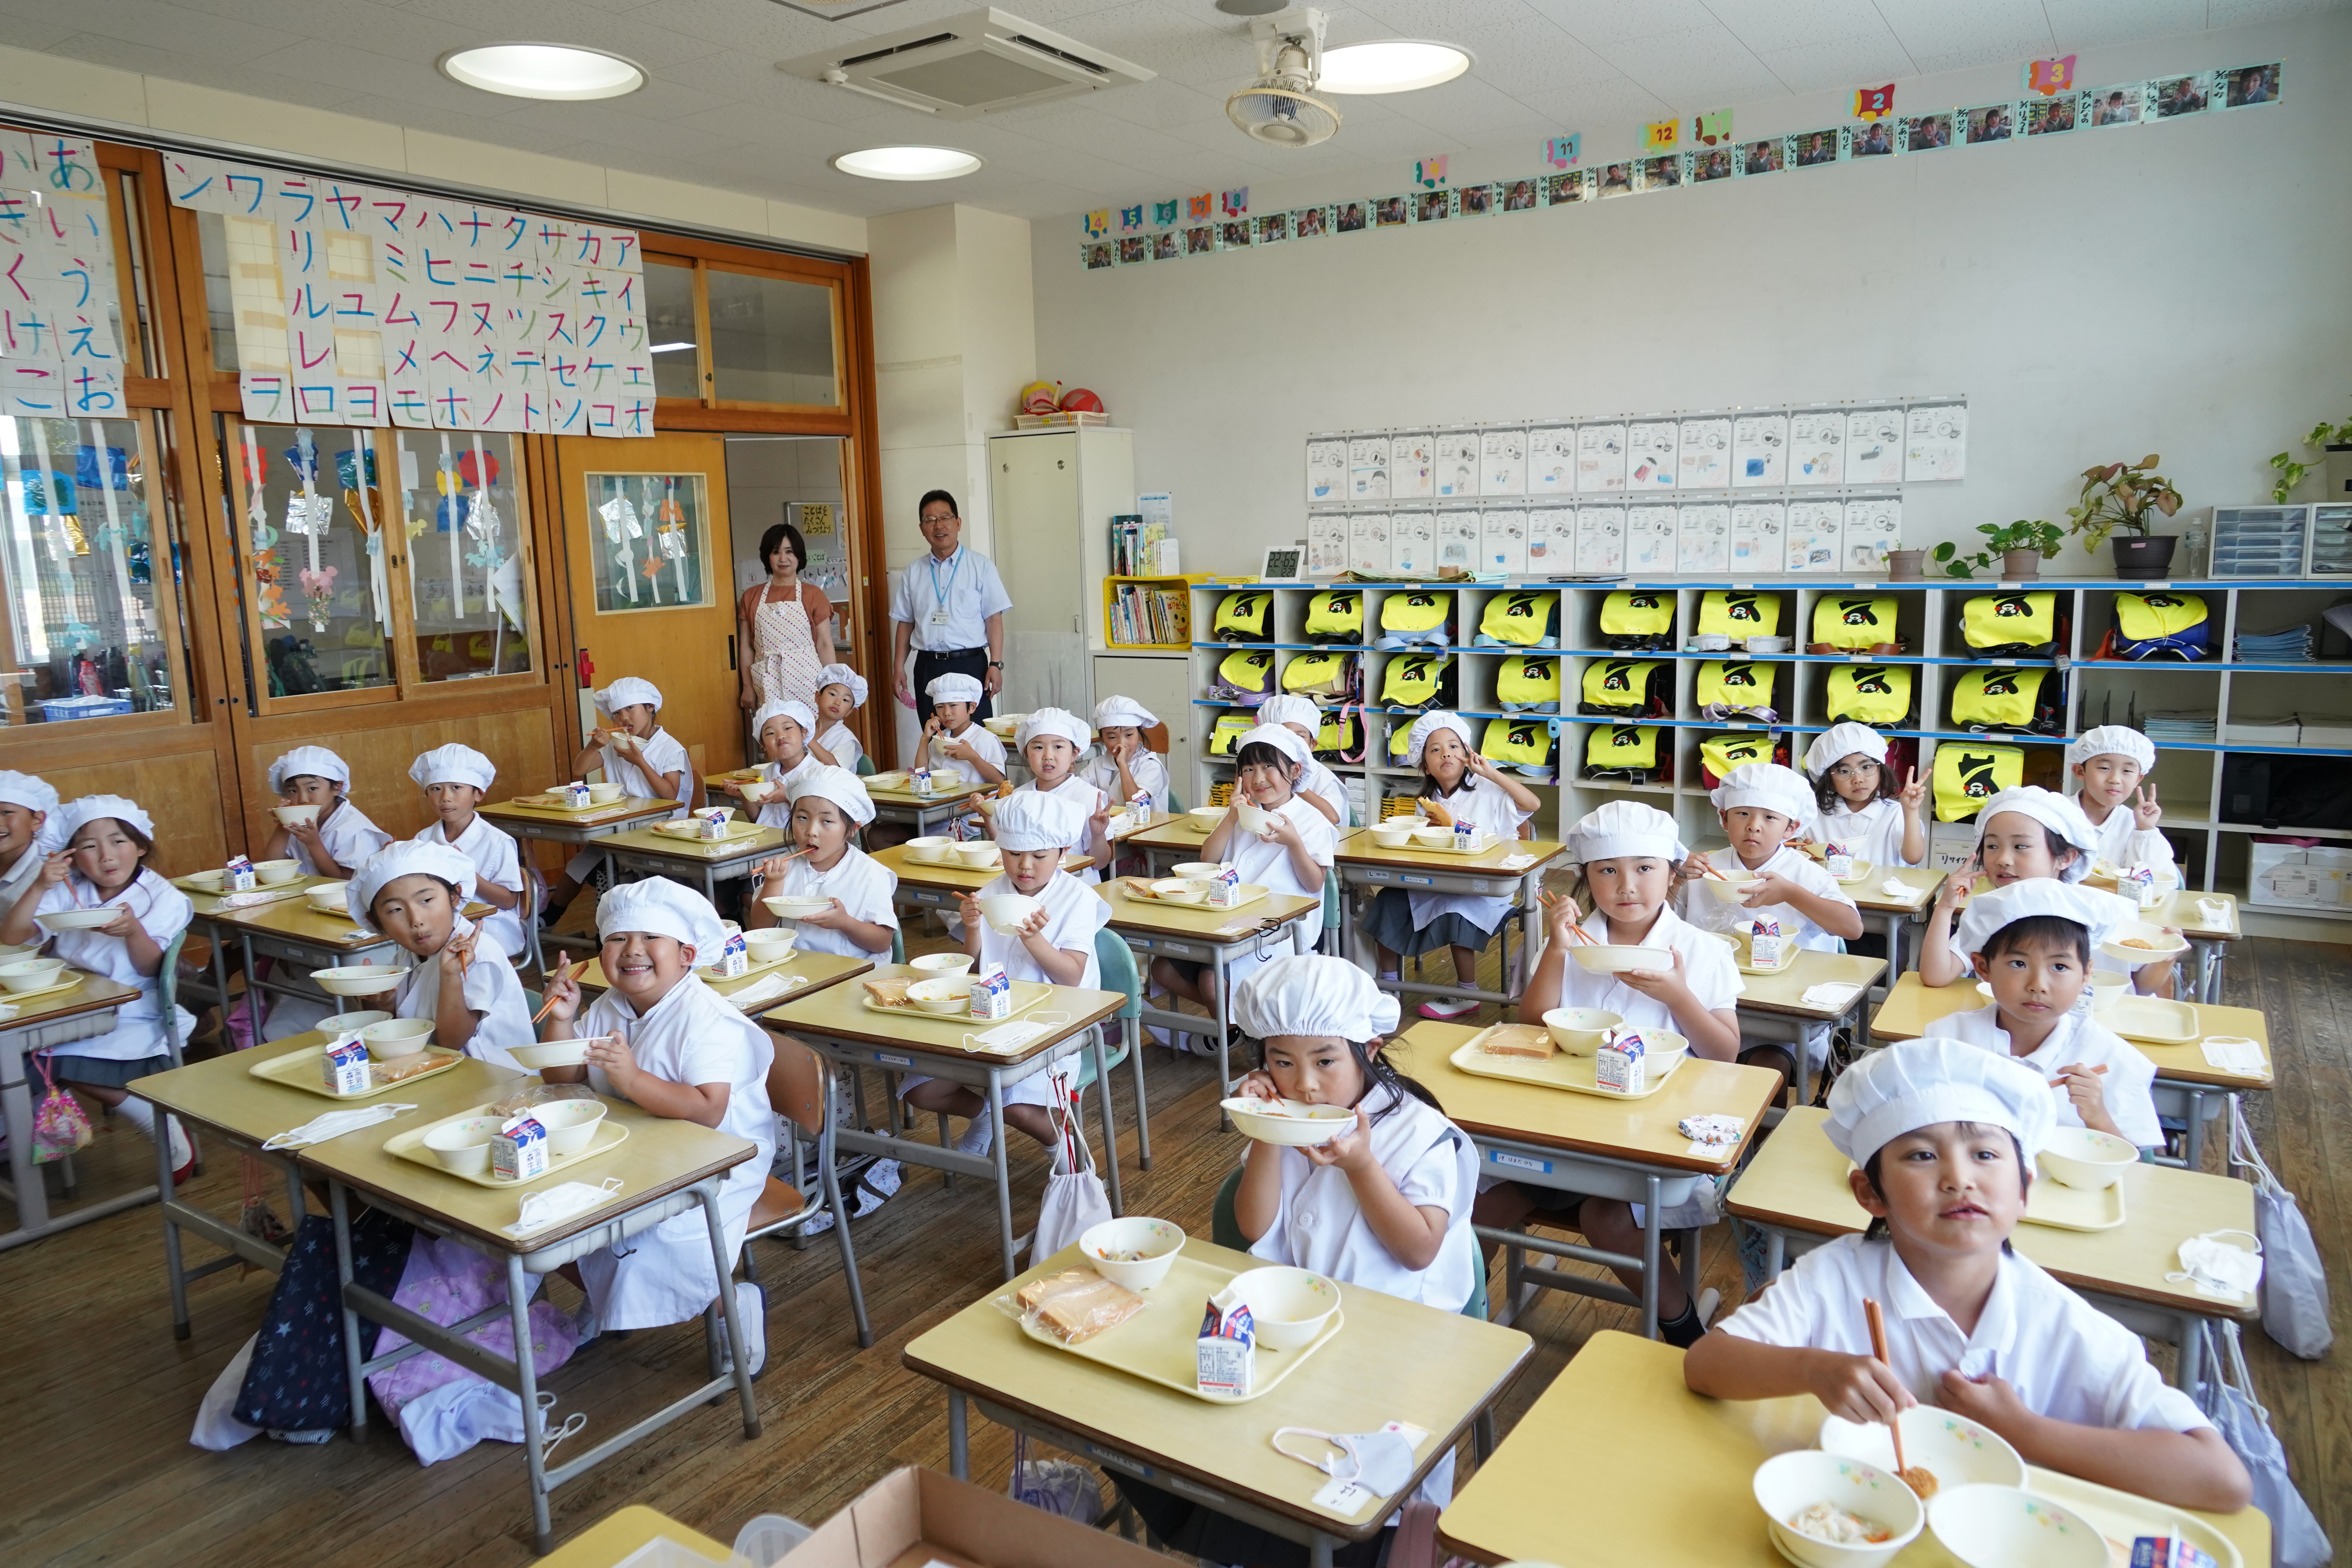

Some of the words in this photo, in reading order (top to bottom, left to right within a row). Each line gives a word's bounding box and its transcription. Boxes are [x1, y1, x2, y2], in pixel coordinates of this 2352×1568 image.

[2050, 63, 2064, 82] 3
[1873, 93, 1884, 109] 2
[1715, 120, 1721, 132] 1
[1657, 127, 1672, 141] 12
[1898, 128, 1907, 149] あいり
[1561, 142, 1573, 155] 11
[1430, 163, 1439, 176] 9
[1196, 201, 1205, 212] 7
[1233, 194, 1241, 207] 8
[1129, 211, 1136, 225] 5
[1163, 209, 1171, 220] 6
[1094, 217, 1103, 229] 4
[804, 506, 828, 515] ことばを
[804, 516, 825, 524] たくさん
[806, 525, 831, 534] みつけよう
[1167, 600, 1187, 610] ばけたくん
[997, 998, 1007, 1006] 森永
[997, 1004, 1007, 1013] 牛乳
[346, 1069, 362, 1080] 森永
[346, 1076, 364, 1086] 牛乳
[527, 1149, 541, 1162] 森永
[528, 1157, 543, 1169] 牛乳
